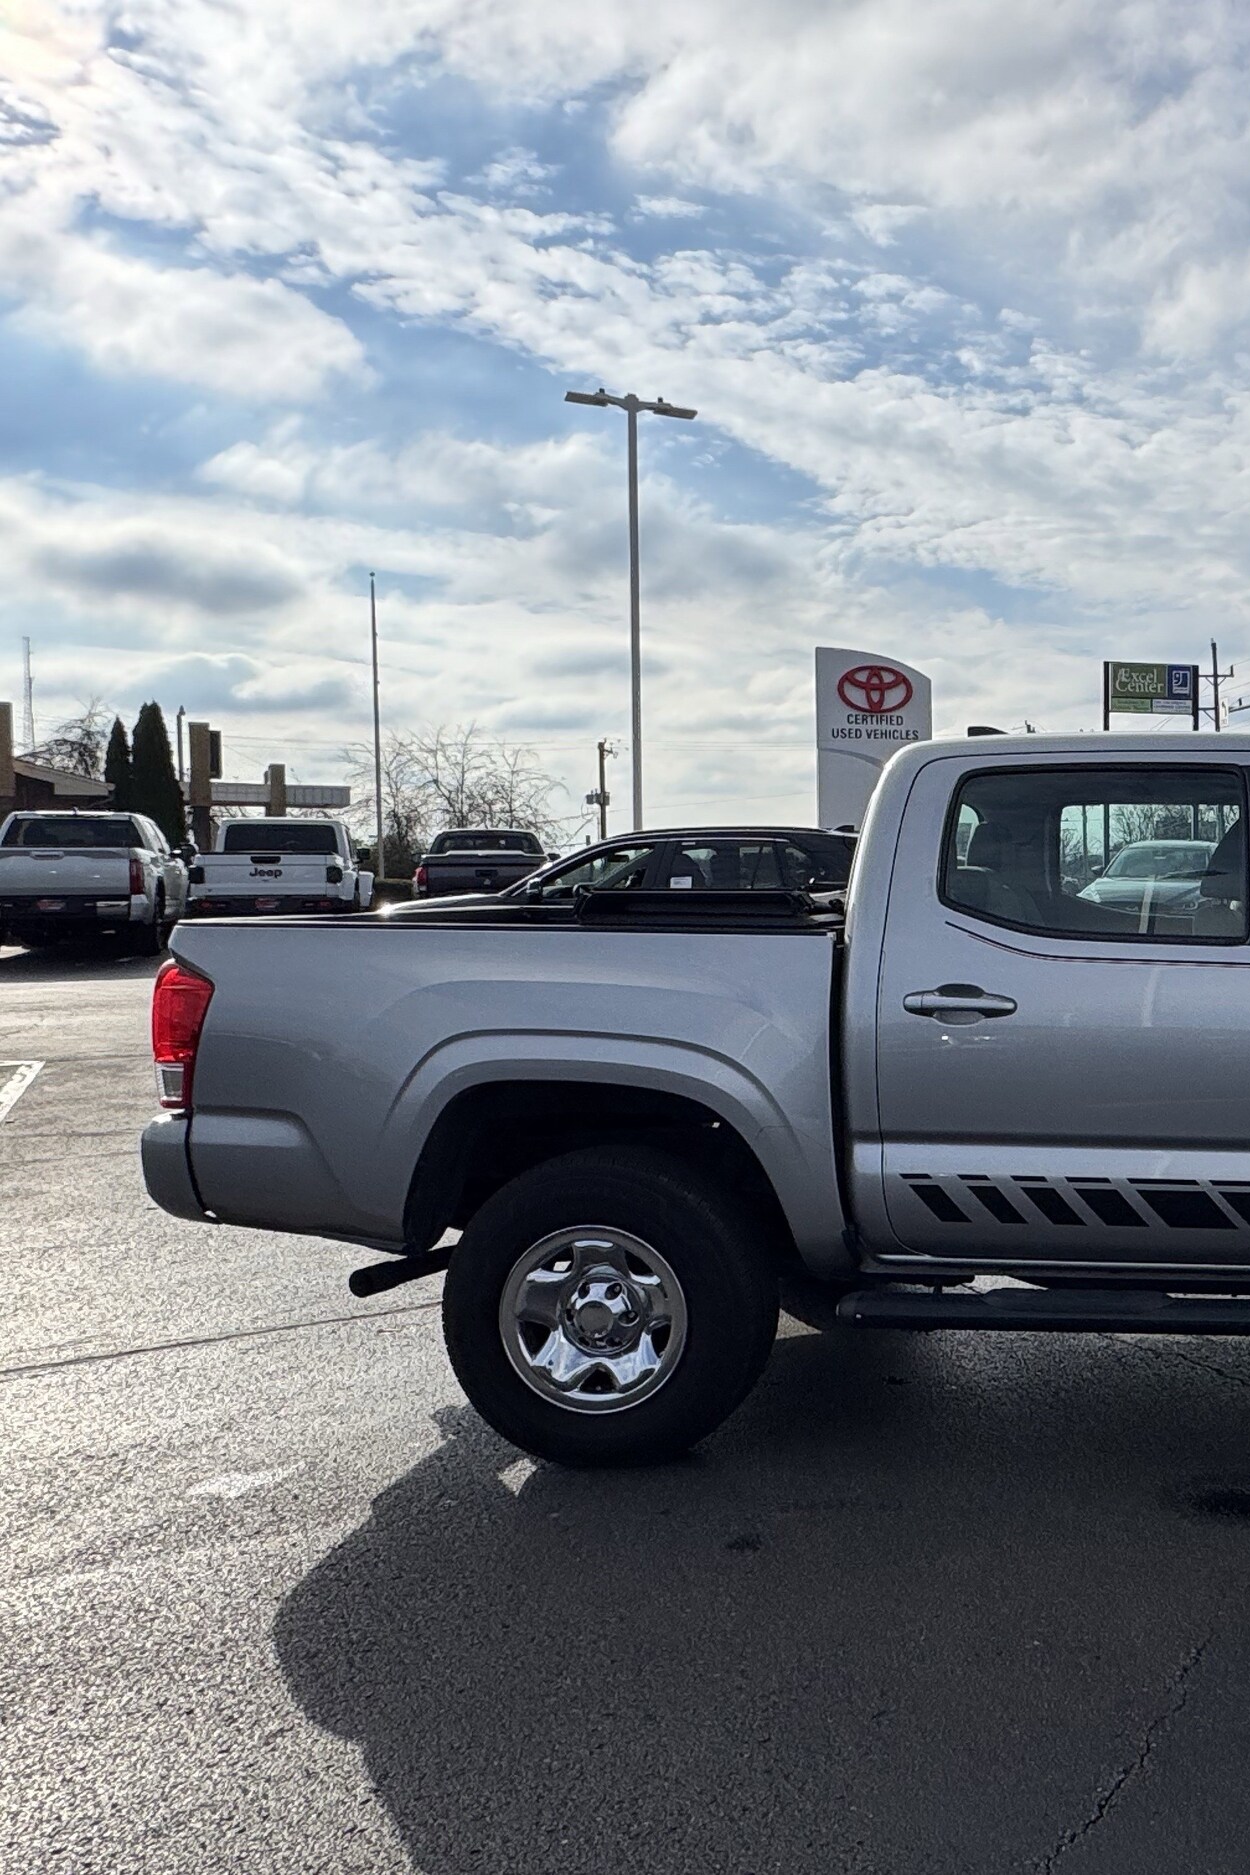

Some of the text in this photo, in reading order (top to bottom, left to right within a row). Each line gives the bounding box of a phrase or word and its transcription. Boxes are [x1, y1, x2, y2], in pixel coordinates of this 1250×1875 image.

[1117, 668, 1157, 683] Excel
[1115, 680, 1164, 693] Center
[847, 714, 904, 726] CERTIFIED
[832, 728, 919, 740] USED VEHICLES
[249, 867, 283, 879] Jeep
